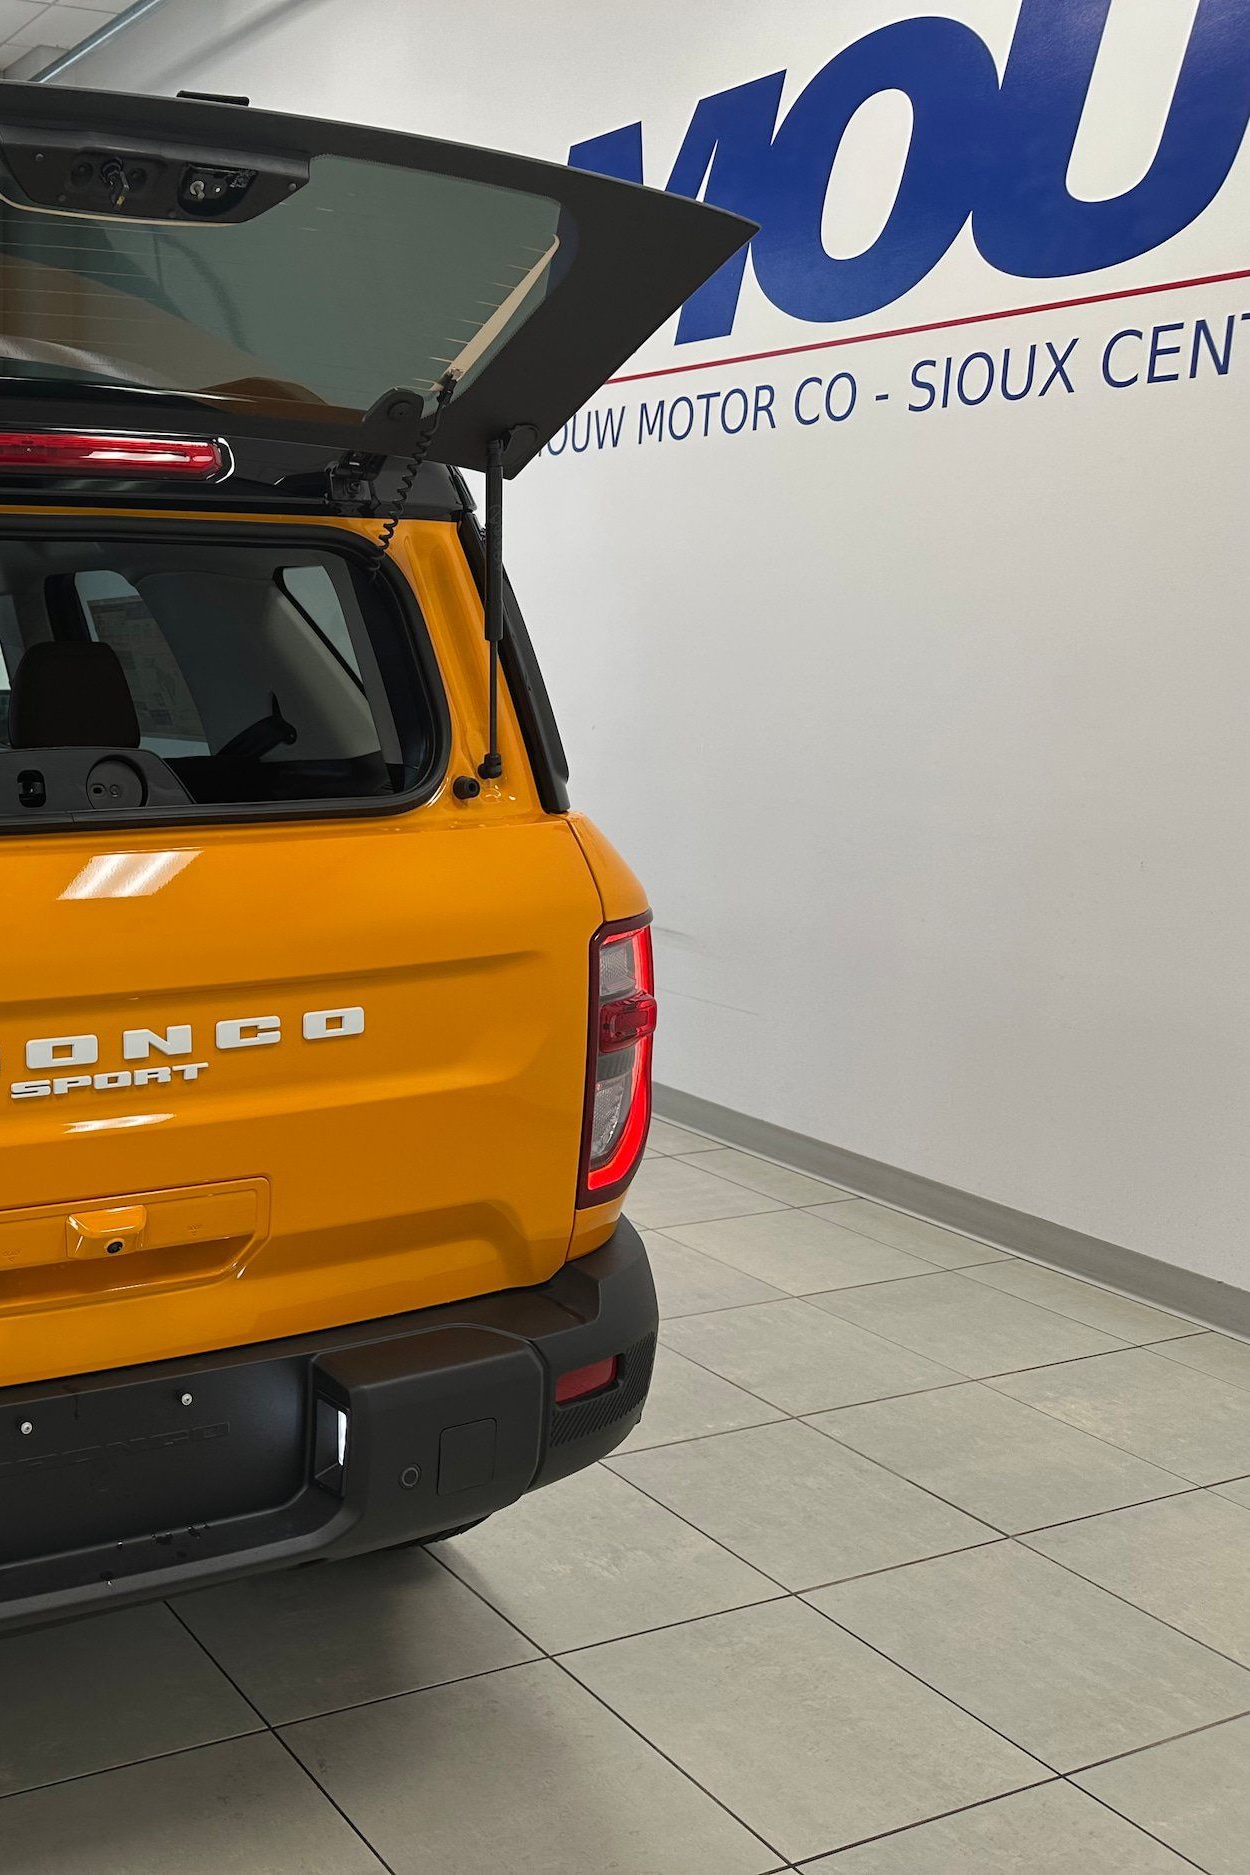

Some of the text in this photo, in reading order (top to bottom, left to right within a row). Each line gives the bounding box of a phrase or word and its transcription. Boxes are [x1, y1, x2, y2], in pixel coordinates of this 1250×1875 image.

[538, 406, 626, 457] OUW
[638, 384, 776, 445] MOTOR
[794, 372, 857, 425] CO
[908, 338, 1080, 412] SIOUX
[1102, 312, 1250, 388] CEN
[11, 1062, 209, 1099] SPORT
